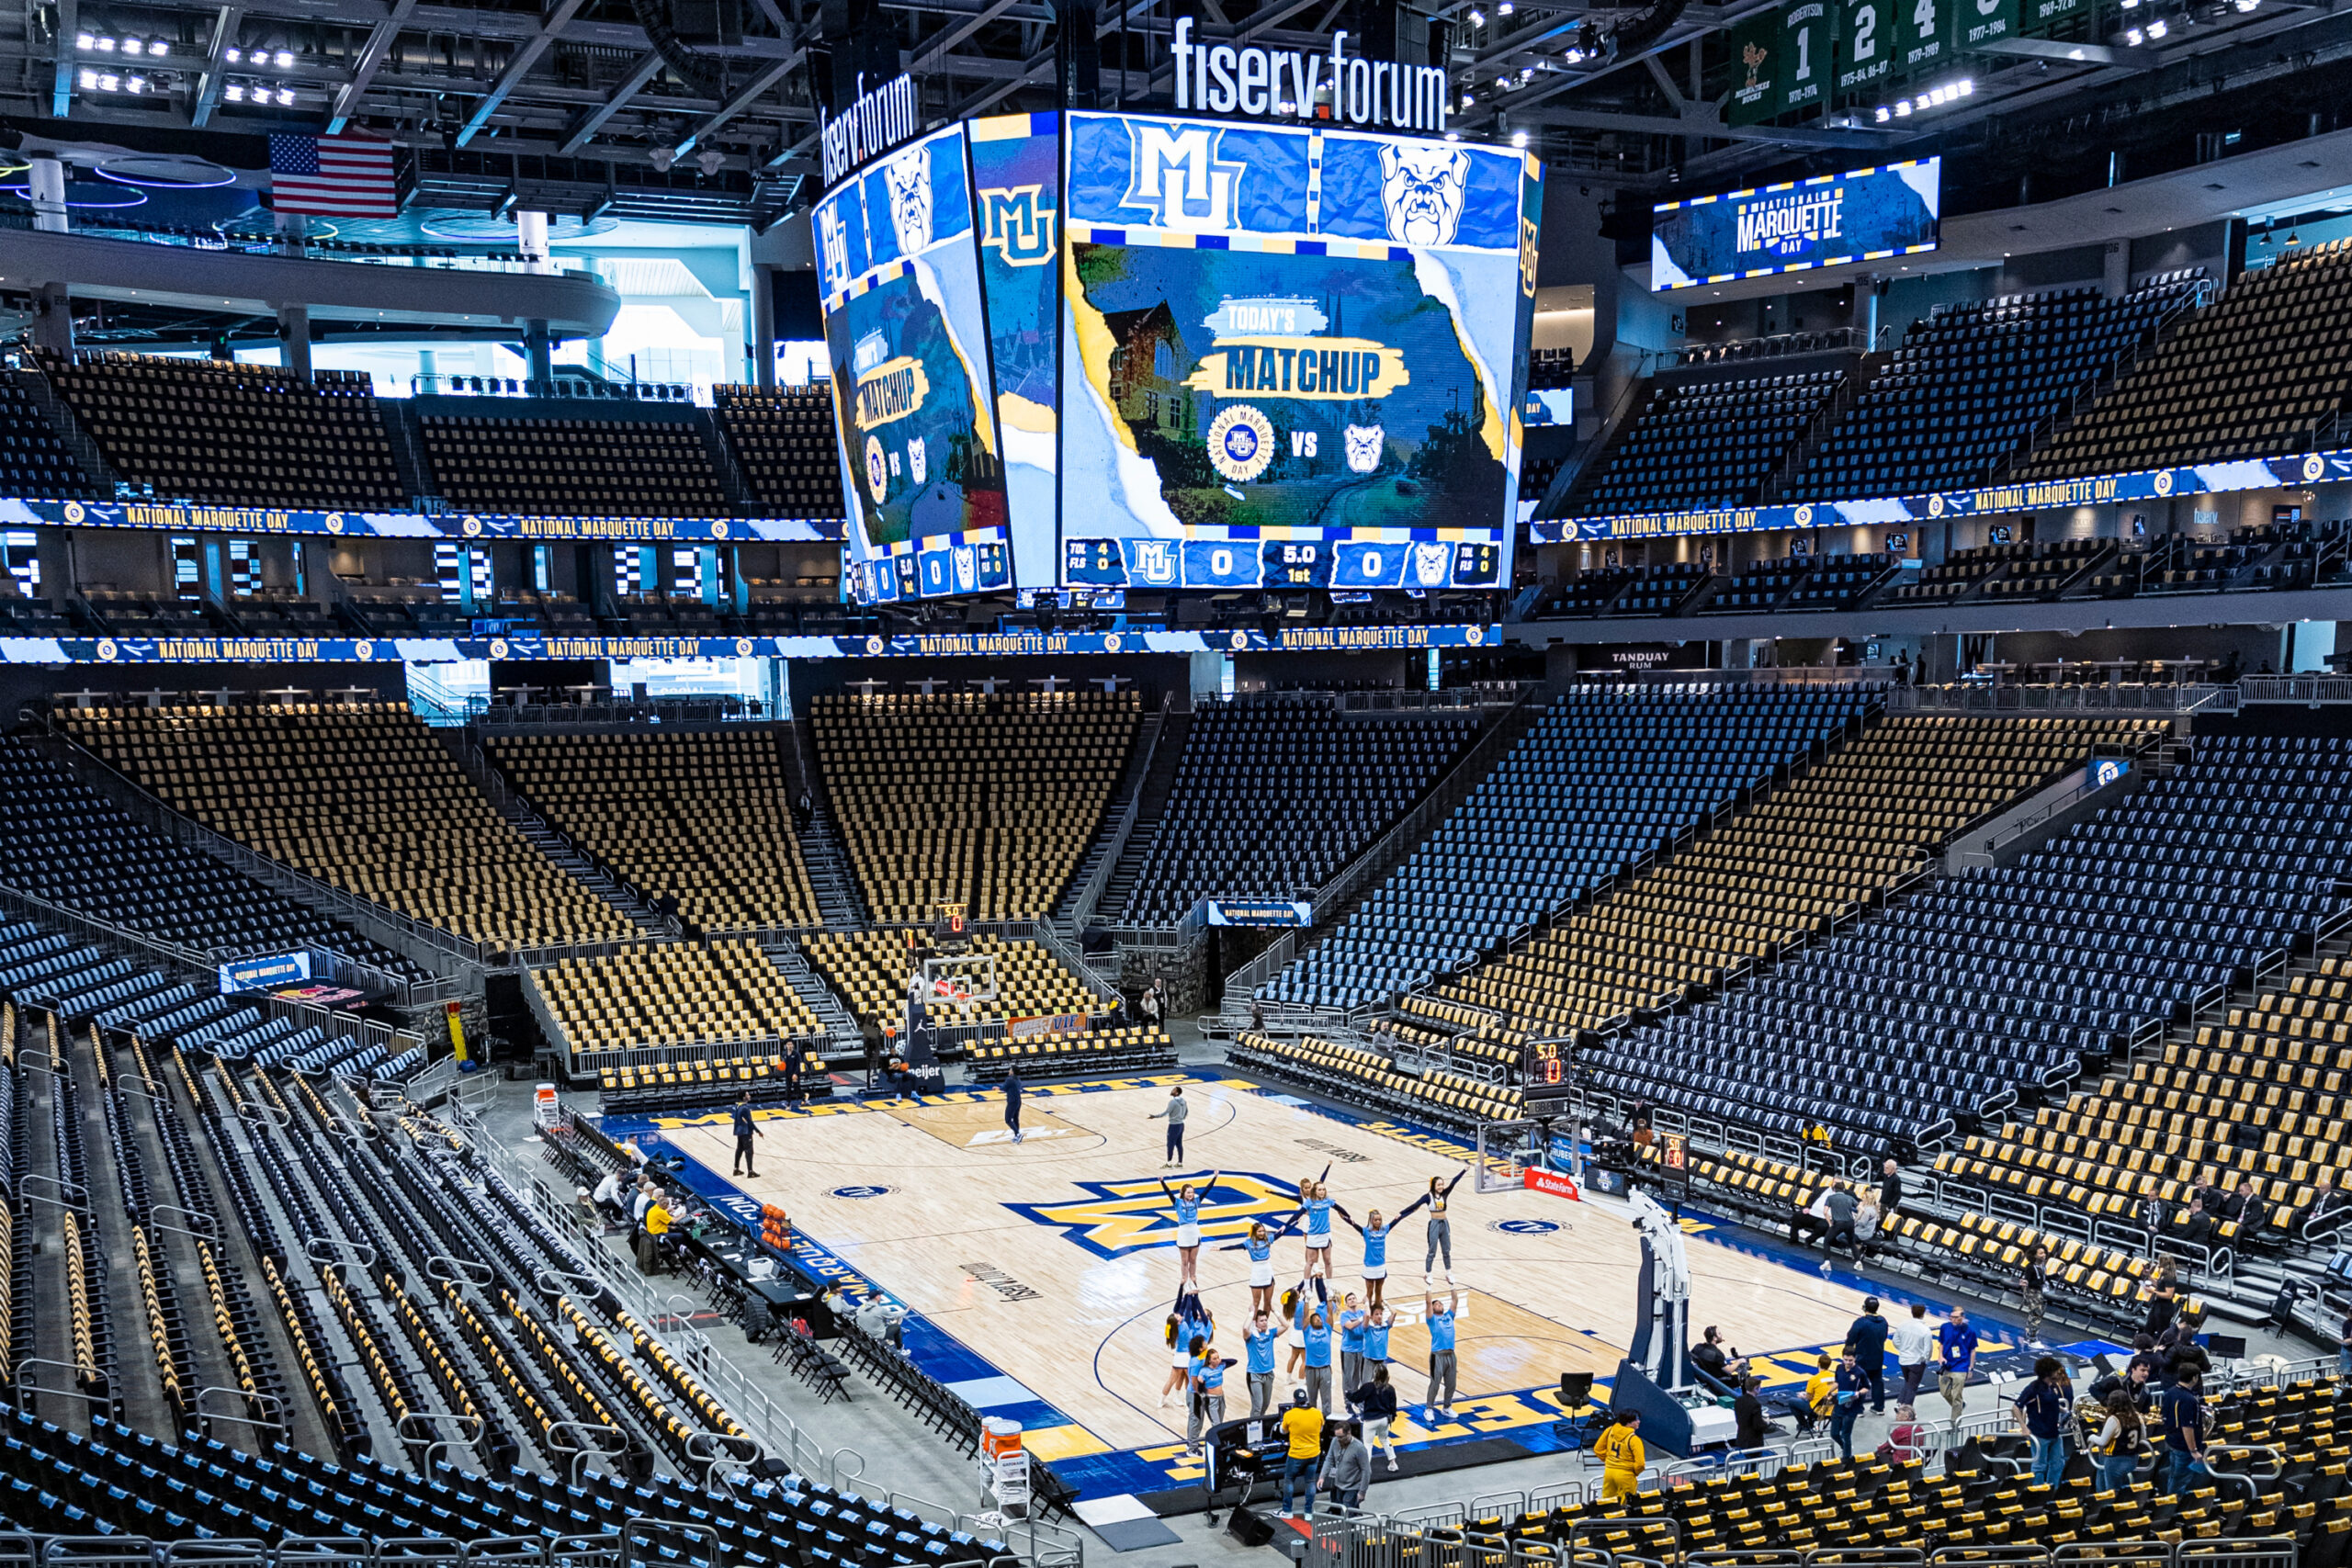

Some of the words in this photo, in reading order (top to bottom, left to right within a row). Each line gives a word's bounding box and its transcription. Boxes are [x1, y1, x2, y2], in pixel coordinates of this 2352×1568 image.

[1787, 3, 1823, 28] ROBERTSON
[1914, 0, 1936, 39] 4
[1854, 5, 1876, 62] 2
[1968, 18, 2006, 42] 1977-1984
[1796, 27, 1810, 81] 1
[1908, 42, 1939, 63] 1979-1989
[1868, 60, 1889, 78] 86-87
[1742, 92, 1761, 105] BUCKS
[1789, 85, 1818, 103] 1970-1974
[1132, 125, 1236, 229] MU
[1760, 191, 1821, 210] NATIONAL
[983, 187, 1054, 265] MU
[1737, 199, 1843, 253] MARQUETTE
[1781, 239, 1803, 254] DAY
[1228, 306, 1295, 332] TODAY'S
[1226, 344, 1380, 395] MATCHUP
[862, 367, 916, 424] MATCHUP
[1526, 402, 1542, 414] DAY
[1291, 431, 1317, 457] VS
[1975, 489, 2024, 511] NATIONAL
[2028, 481, 2092, 505] MARQUETTE
[2095, 479, 2118, 499] DAY
[127, 507, 188, 526] NATIONAL
[192, 510, 263, 528] MARQUETTE
[266, 513, 288, 529] DAY
[521, 519, 577, 536] NATIONAL
[582, 521, 650, 536] MARQUETTE
[653, 521, 674, 536] DAY
[1611, 515, 1661, 536] NATIONAL
[1666, 512, 1731, 534] MARQUETTE
[1735, 511, 1757, 529] DAY
[1097, 542, 1108, 556] 4
[1283, 545, 1316, 564] 5.0
[1480, 546, 1489, 558] 4
[931, 559, 942, 585] 0
[1097, 558, 1109, 570] 0
[1136, 542, 1174, 583] MU
[1211, 549, 1233, 576] 0
[1362, 551, 1382, 578] 0
[1479, 560, 1489, 573] 0
[880, 566, 888, 591] 0
[1288, 568, 1311, 583] 1st
[547, 640, 603, 657] NATIONAL
[607, 640, 674, 656] MARQUETTE
[679, 639, 700, 655] DAY
[920, 637, 974, 652] NATIONAL
[978, 636, 1043, 652] MARQUETTE
[1047, 636, 1068, 651] DAY
[1283, 631, 1335, 648] NATIONAL
[1339, 629, 1404, 646] MARQUETTE
[1408, 628, 1429, 645] DAY
[159, 641, 220, 659] NATIONAL
[223, 641, 293, 659] MARQUETTE
[298, 641, 319, 659] DAY
[1612, 652, 1669, 663] TANDUAY
[1629, 661, 1652, 671] RUM
[952, 915, 962, 932] 0
[1536, 1043, 1556, 1059] 5.0
[1547, 1059, 1561, 1083] 0
[2127, 1429, 2139, 1450] 3
[1611, 1442, 1621, 1459] 4
